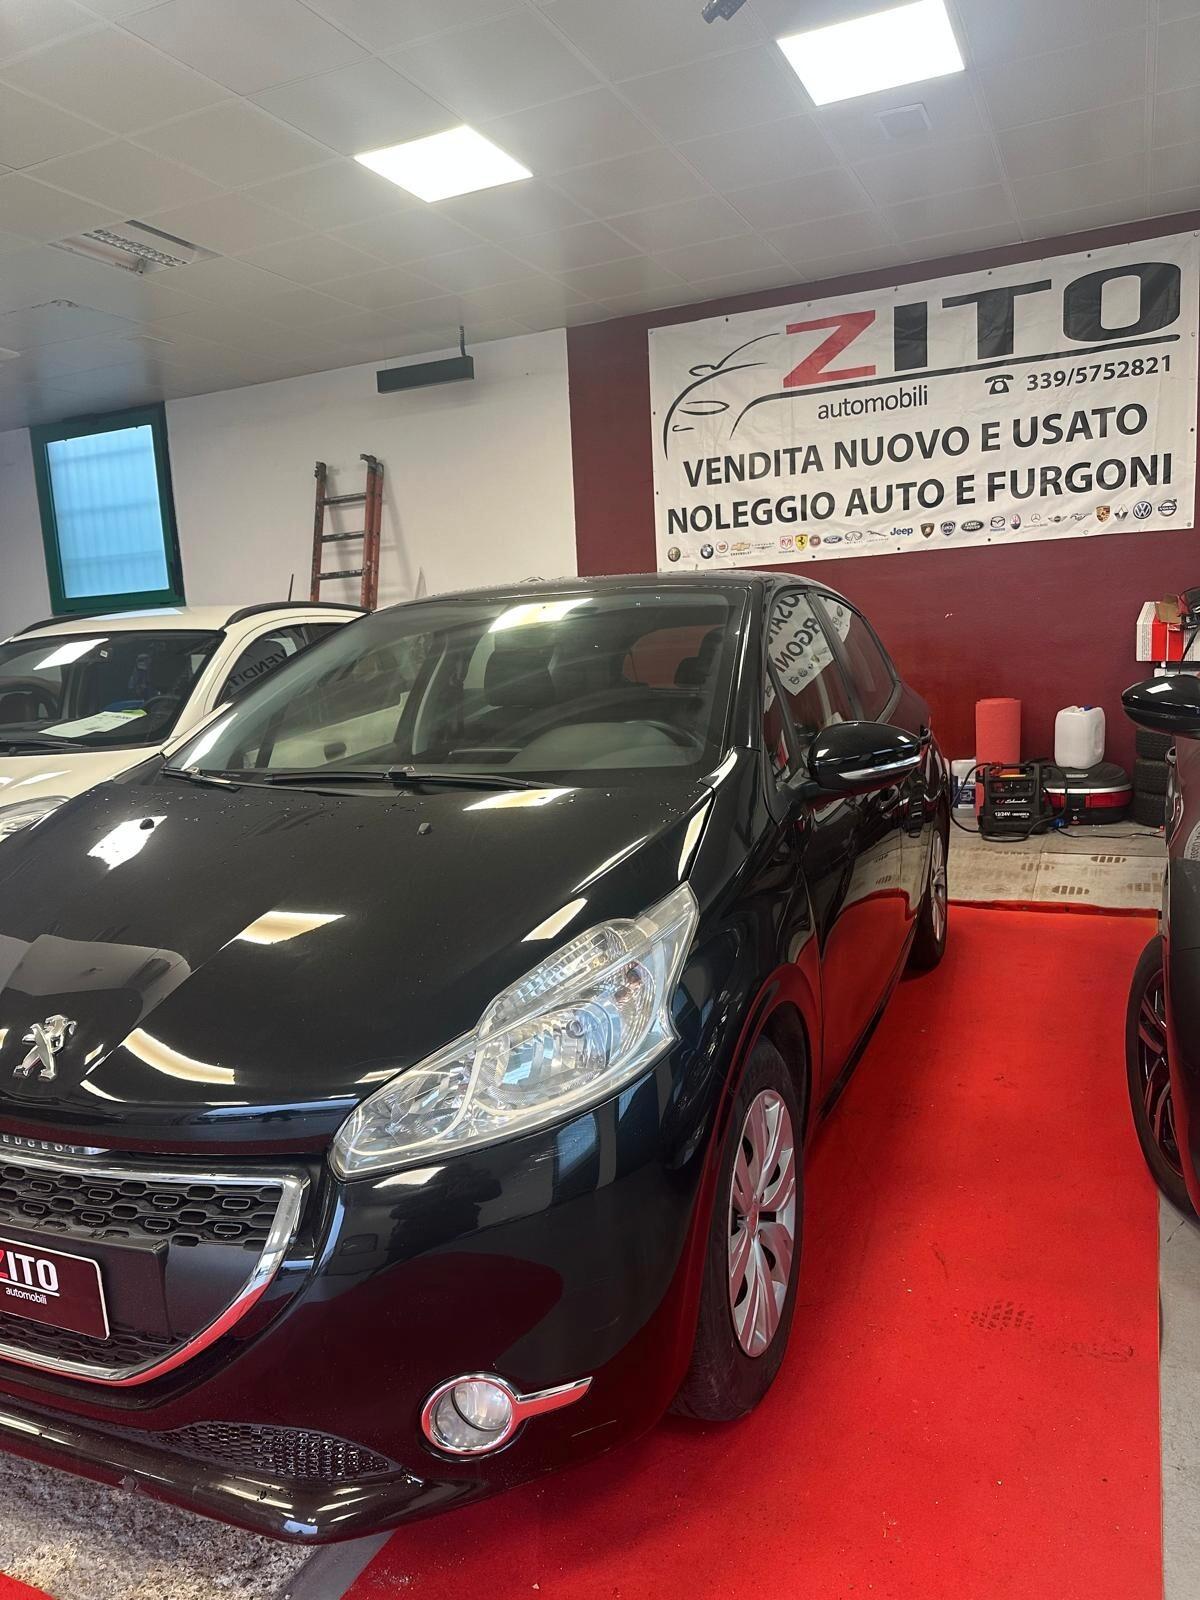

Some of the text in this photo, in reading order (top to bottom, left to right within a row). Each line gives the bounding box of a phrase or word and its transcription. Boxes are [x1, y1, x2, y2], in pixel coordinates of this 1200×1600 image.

[783, 262, 1181, 388] ZITO
[1027, 355, 1171, 391] 339/5752821
[817, 384, 928, 420] automobili
[683, 403, 1148, 488] VENDITA NUOVO E USATO
[667, 453, 1172, 535] NOLEGGIO AUTO E FURGONI
[890, 527, 914, 536] Jeep
[5, 1287, 48, 1305] automobili
